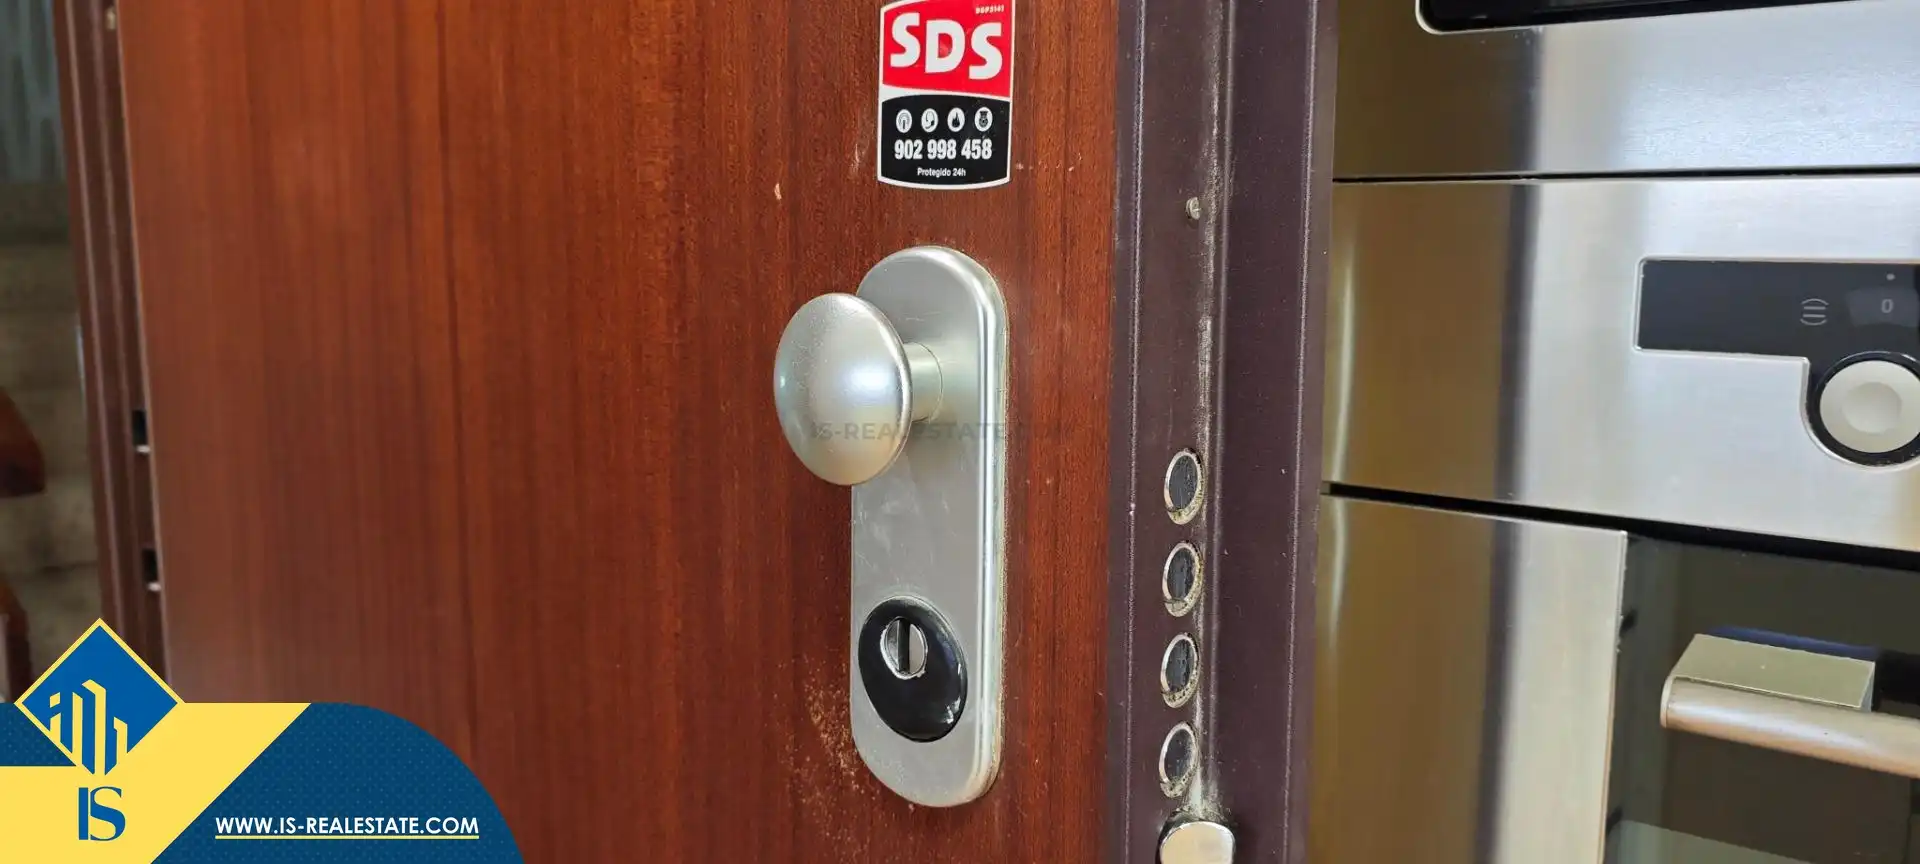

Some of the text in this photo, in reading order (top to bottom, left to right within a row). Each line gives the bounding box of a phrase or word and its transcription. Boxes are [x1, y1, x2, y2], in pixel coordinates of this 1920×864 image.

[890, 12, 1003, 80] SDS
[894, 138, 993, 160] 902 998 458
[917, 167, 967, 178] Protegido 24h
